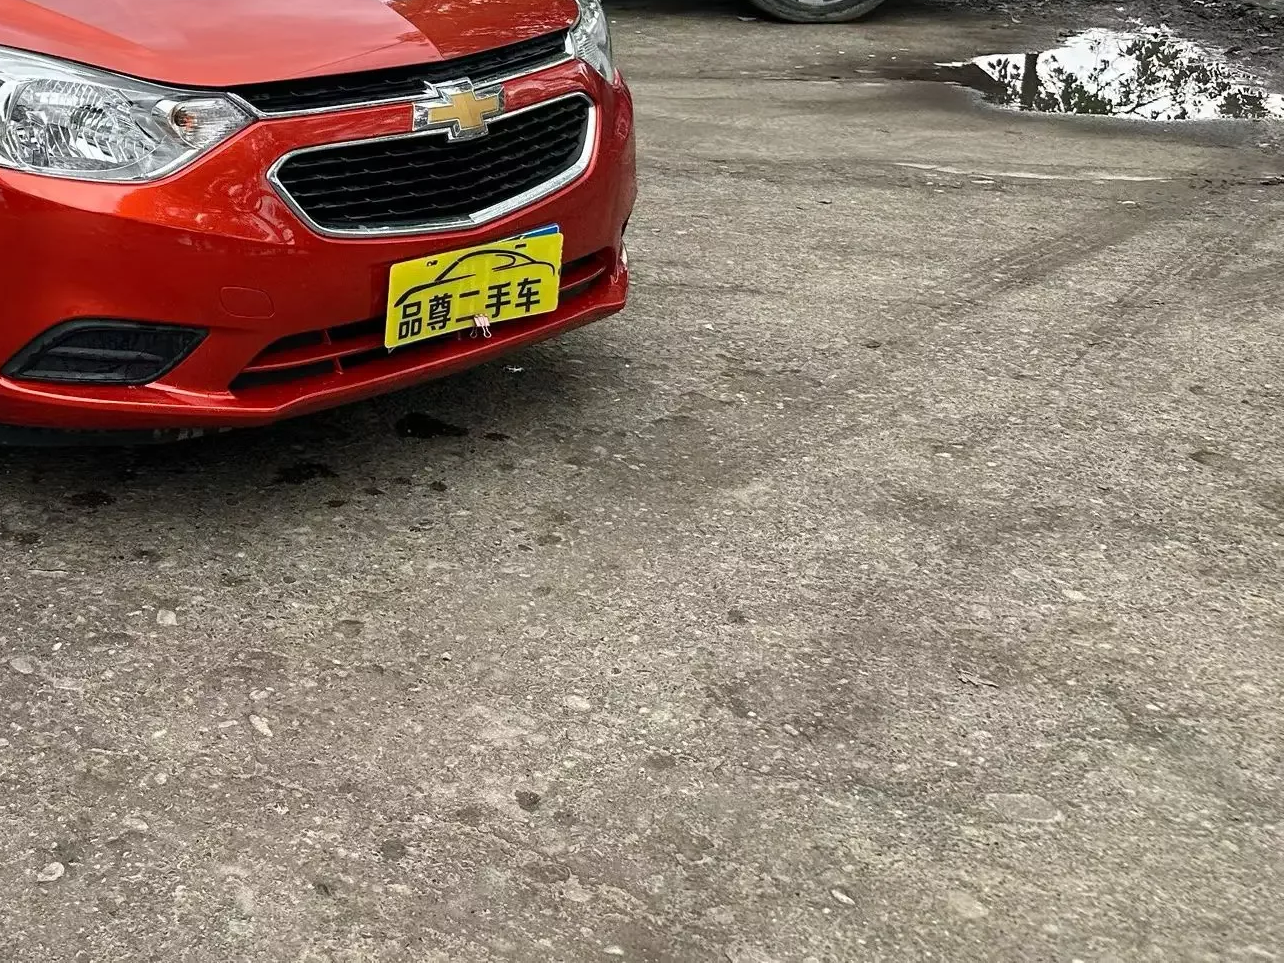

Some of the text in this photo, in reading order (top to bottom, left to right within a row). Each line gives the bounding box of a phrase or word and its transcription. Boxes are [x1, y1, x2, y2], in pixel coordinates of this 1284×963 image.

[398, 277, 542, 341] 品尊二手车
